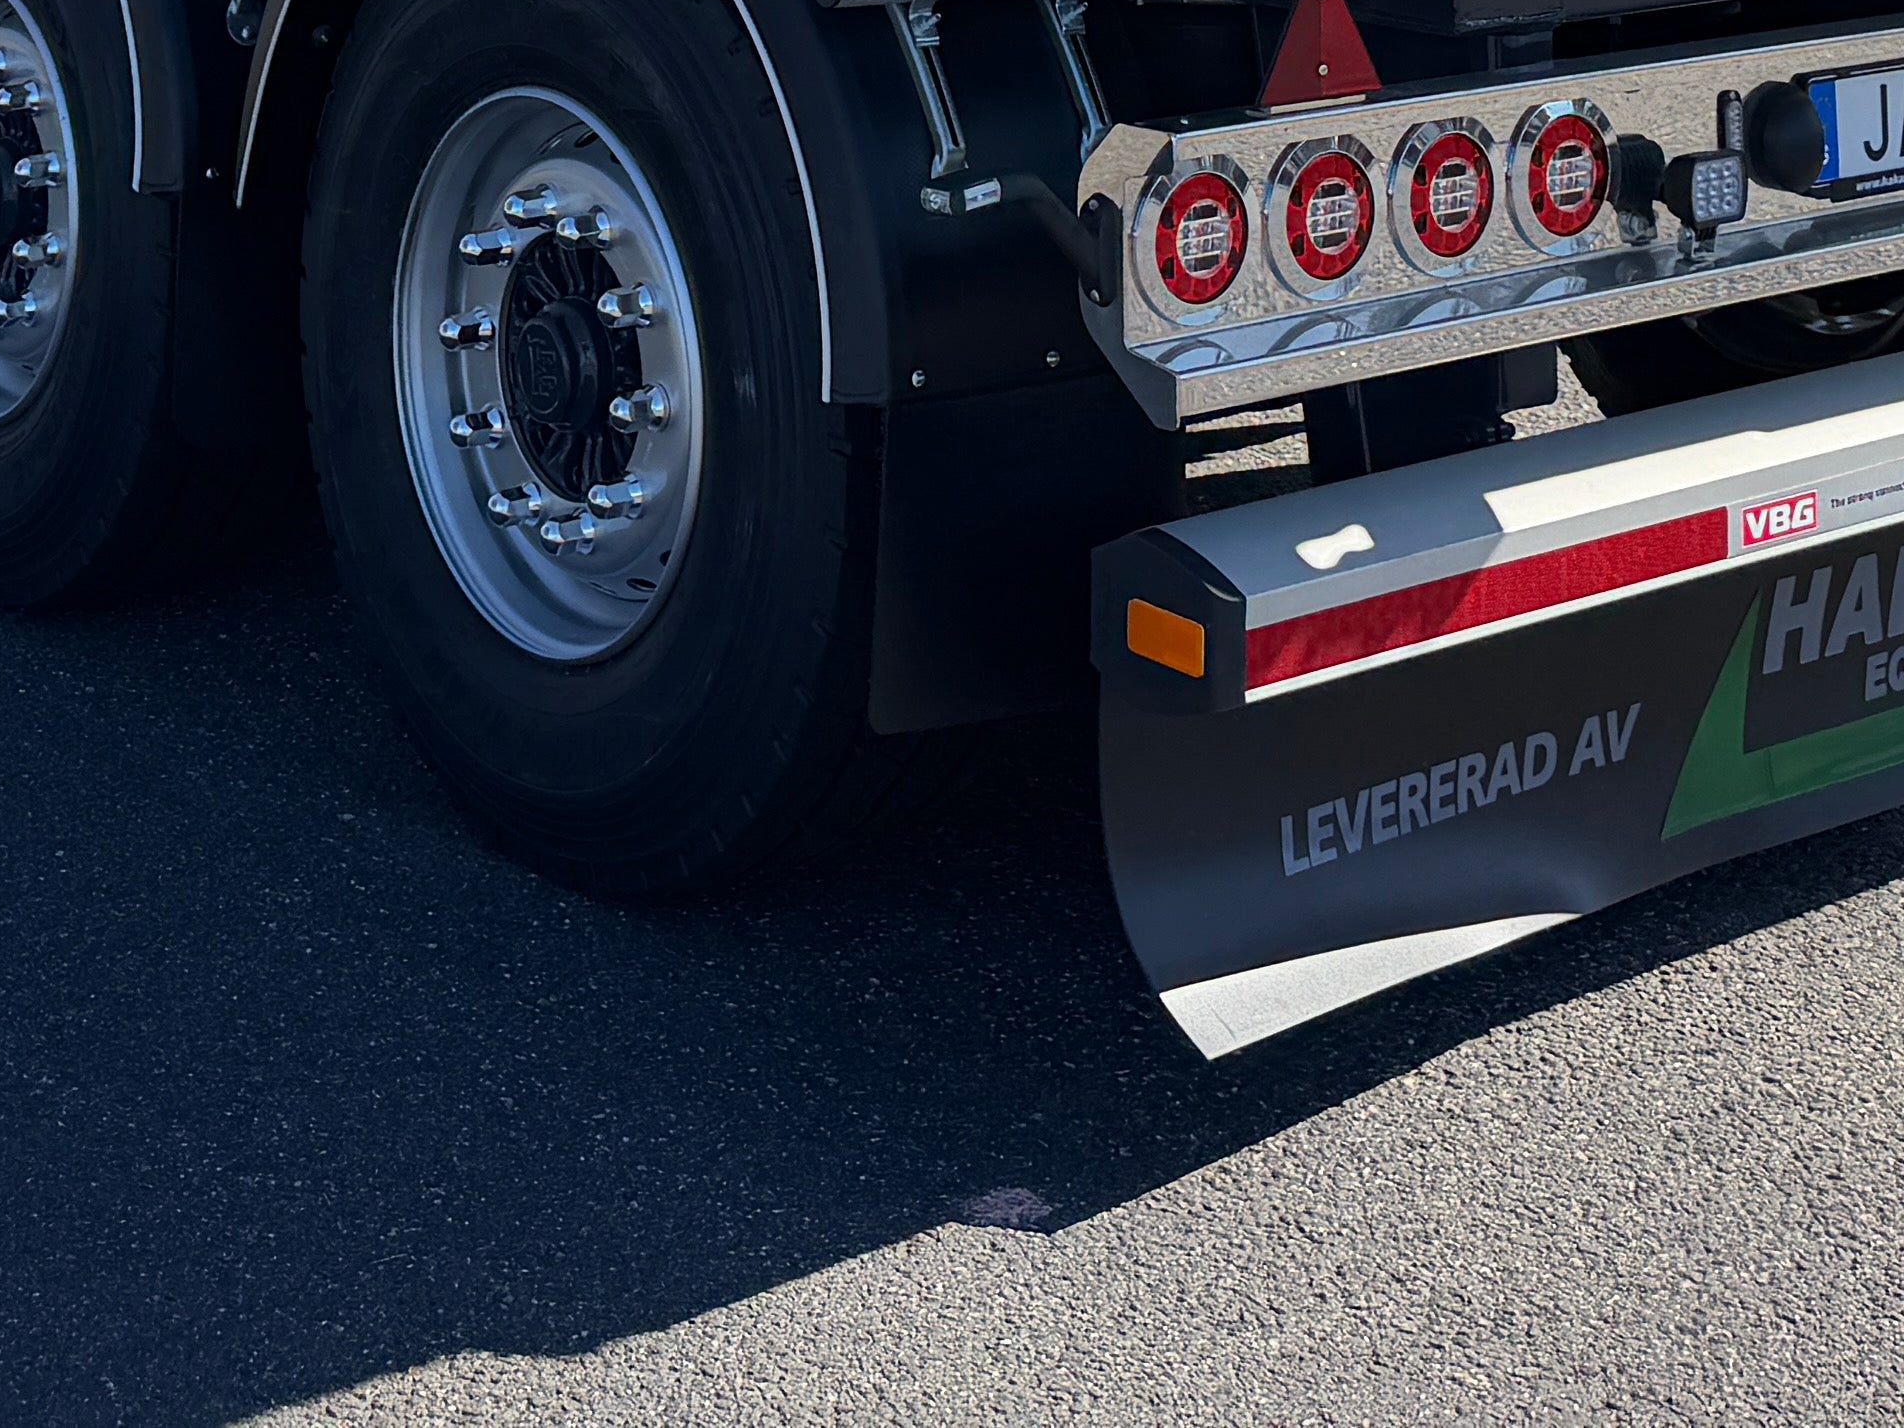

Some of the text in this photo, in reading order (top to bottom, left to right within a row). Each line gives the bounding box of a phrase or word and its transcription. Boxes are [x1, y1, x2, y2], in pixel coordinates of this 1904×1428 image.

[1745, 496, 1816, 539] VBG
[1280, 702, 1642, 878] LEVERERAD AV
